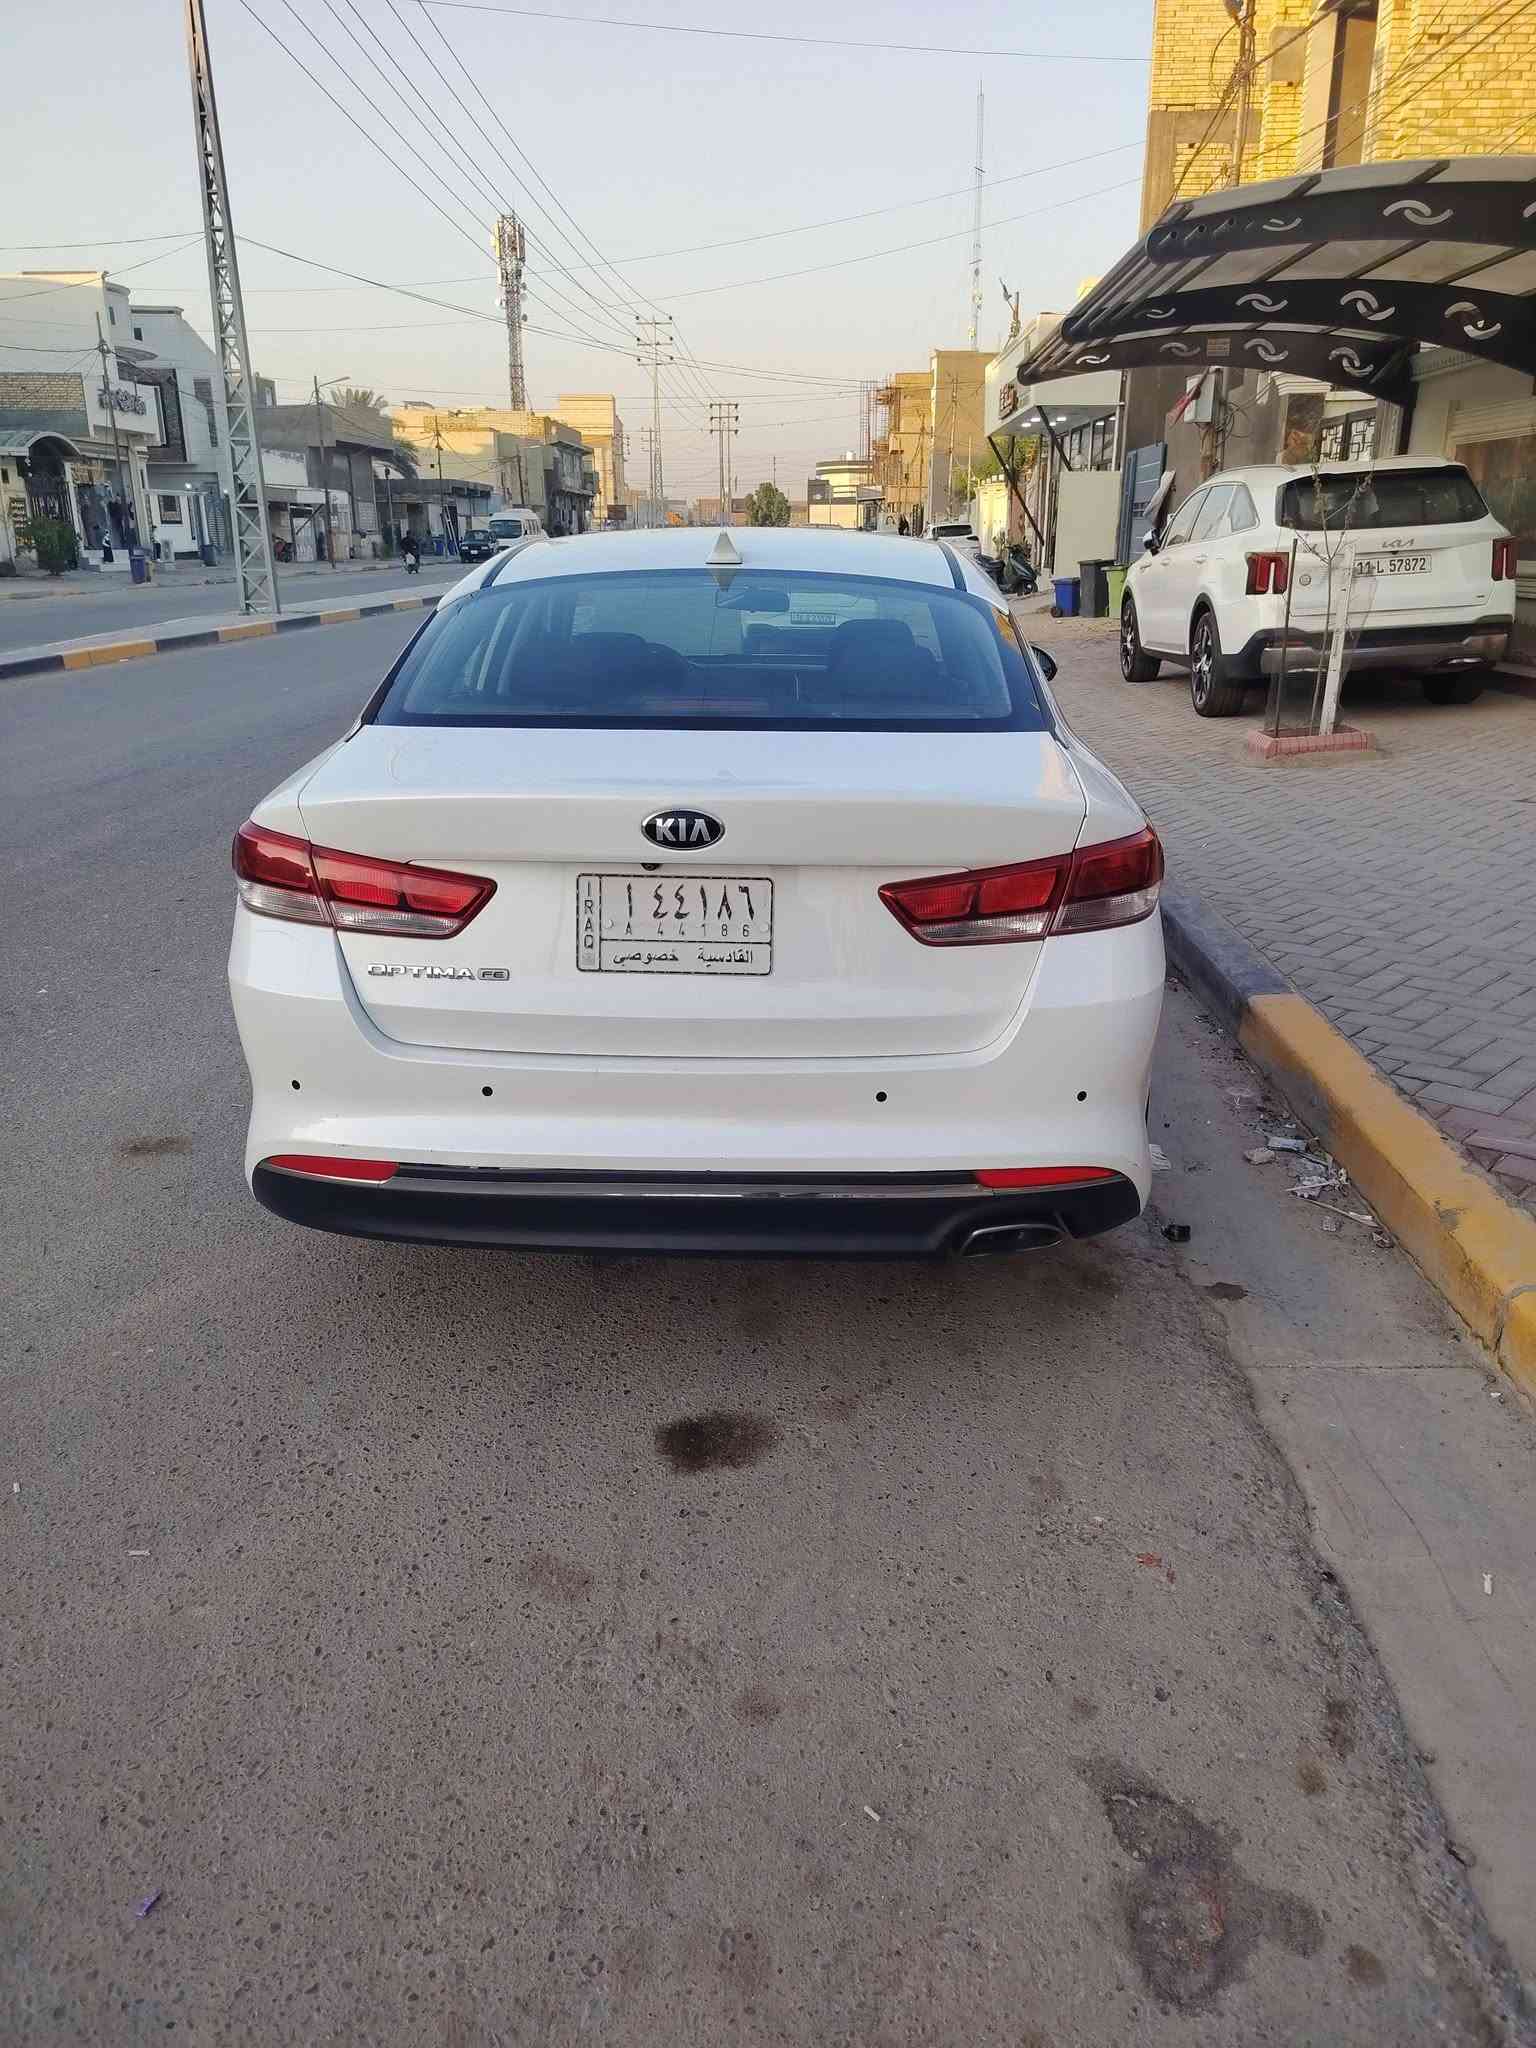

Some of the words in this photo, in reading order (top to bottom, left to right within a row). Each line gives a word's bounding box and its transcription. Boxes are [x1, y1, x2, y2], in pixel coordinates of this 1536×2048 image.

[1389, 557, 1426, 573] 57872
[655, 817, 711, 842] KIA
[584, 881, 594, 949] IRAQ
[697, 945, 754, 968] القادسية
[367, 962, 476, 981] OPTIMA
